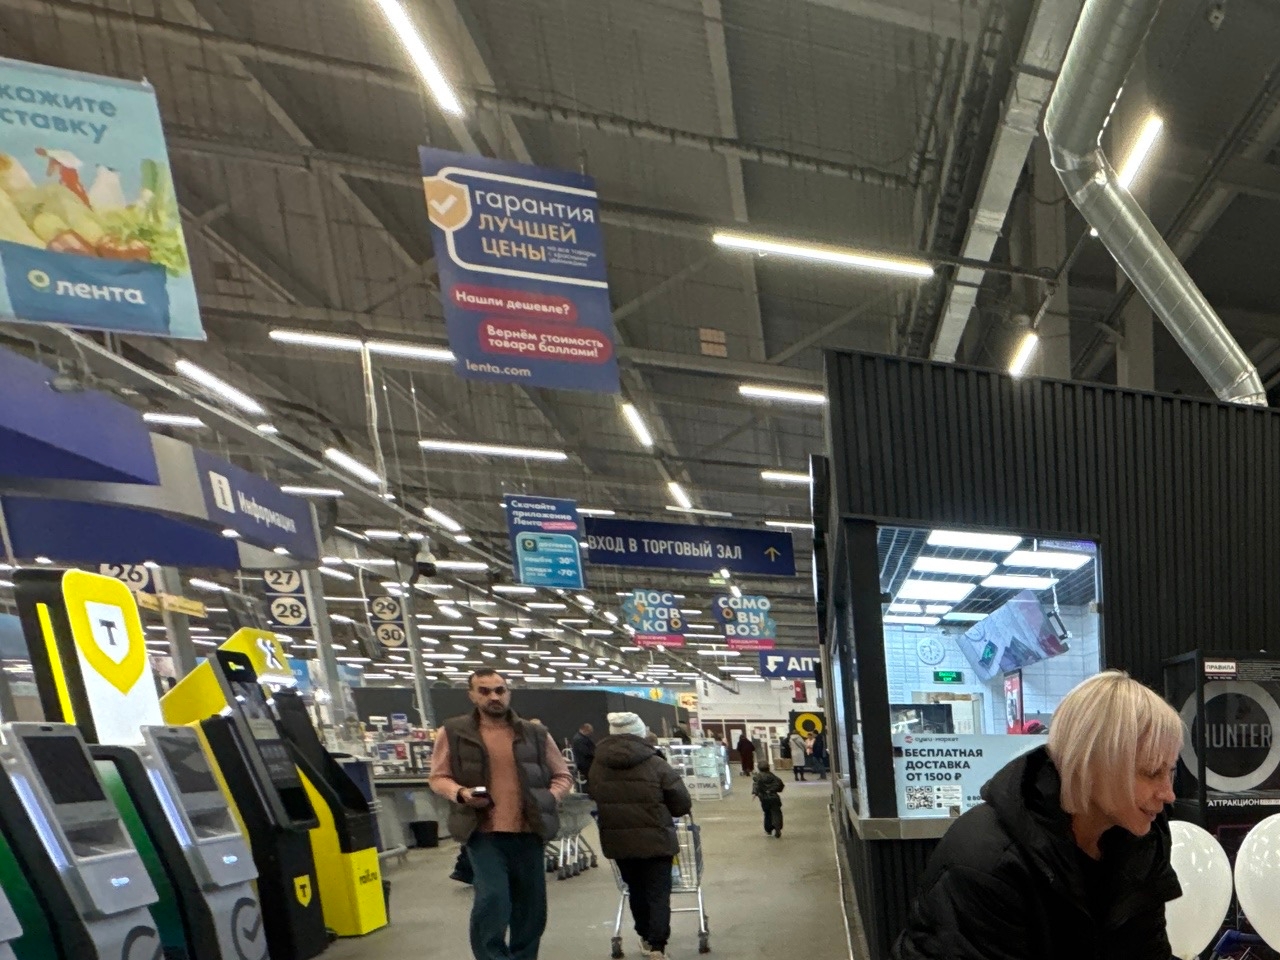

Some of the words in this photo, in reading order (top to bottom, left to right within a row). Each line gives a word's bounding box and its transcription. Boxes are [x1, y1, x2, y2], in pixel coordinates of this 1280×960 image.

[475, 190, 595, 223] гарантия
[478, 214, 577, 244] ЛУЧШЕЙ
[481, 237, 547, 261] ЦЕНЫ
[56, 279, 145, 304] лента
[455, 290, 503, 307] Нашли
[506, 300, 570, 315] дешевле?
[486, 324, 537, 341] Вернём
[540, 332, 604, 348] стоимость
[488, 338, 535, 353] товара
[539, 341, 599, 358] баллами!
[465, 359, 532, 377] lenta.com
[511, 500, 557, 511] Скачайте
[512, 510, 572, 521] приложение
[513, 517, 542, 527] Лента
[587, 535, 625, 553] ВХОД
[629, 538, 638, 552] В
[641, 539, 713, 558] ТОРГОВЫЙ
[717, 543, 742, 559] ЗАЛ
[269, 571, 293, 585] 27
[275, 603, 303, 619] 28
[375, 602, 397, 615] 29
[381, 628, 401, 641] 30
[904, 749, 983, 758] БЕСПЛАТНАЯ
[905, 761, 971, 770] ДОСТАВКА
[906, 773, 922, 781] ОТ
[924, 773, 952, 781] 1500
[1208, 799, 1260, 807] АТТРАКЦИОН
